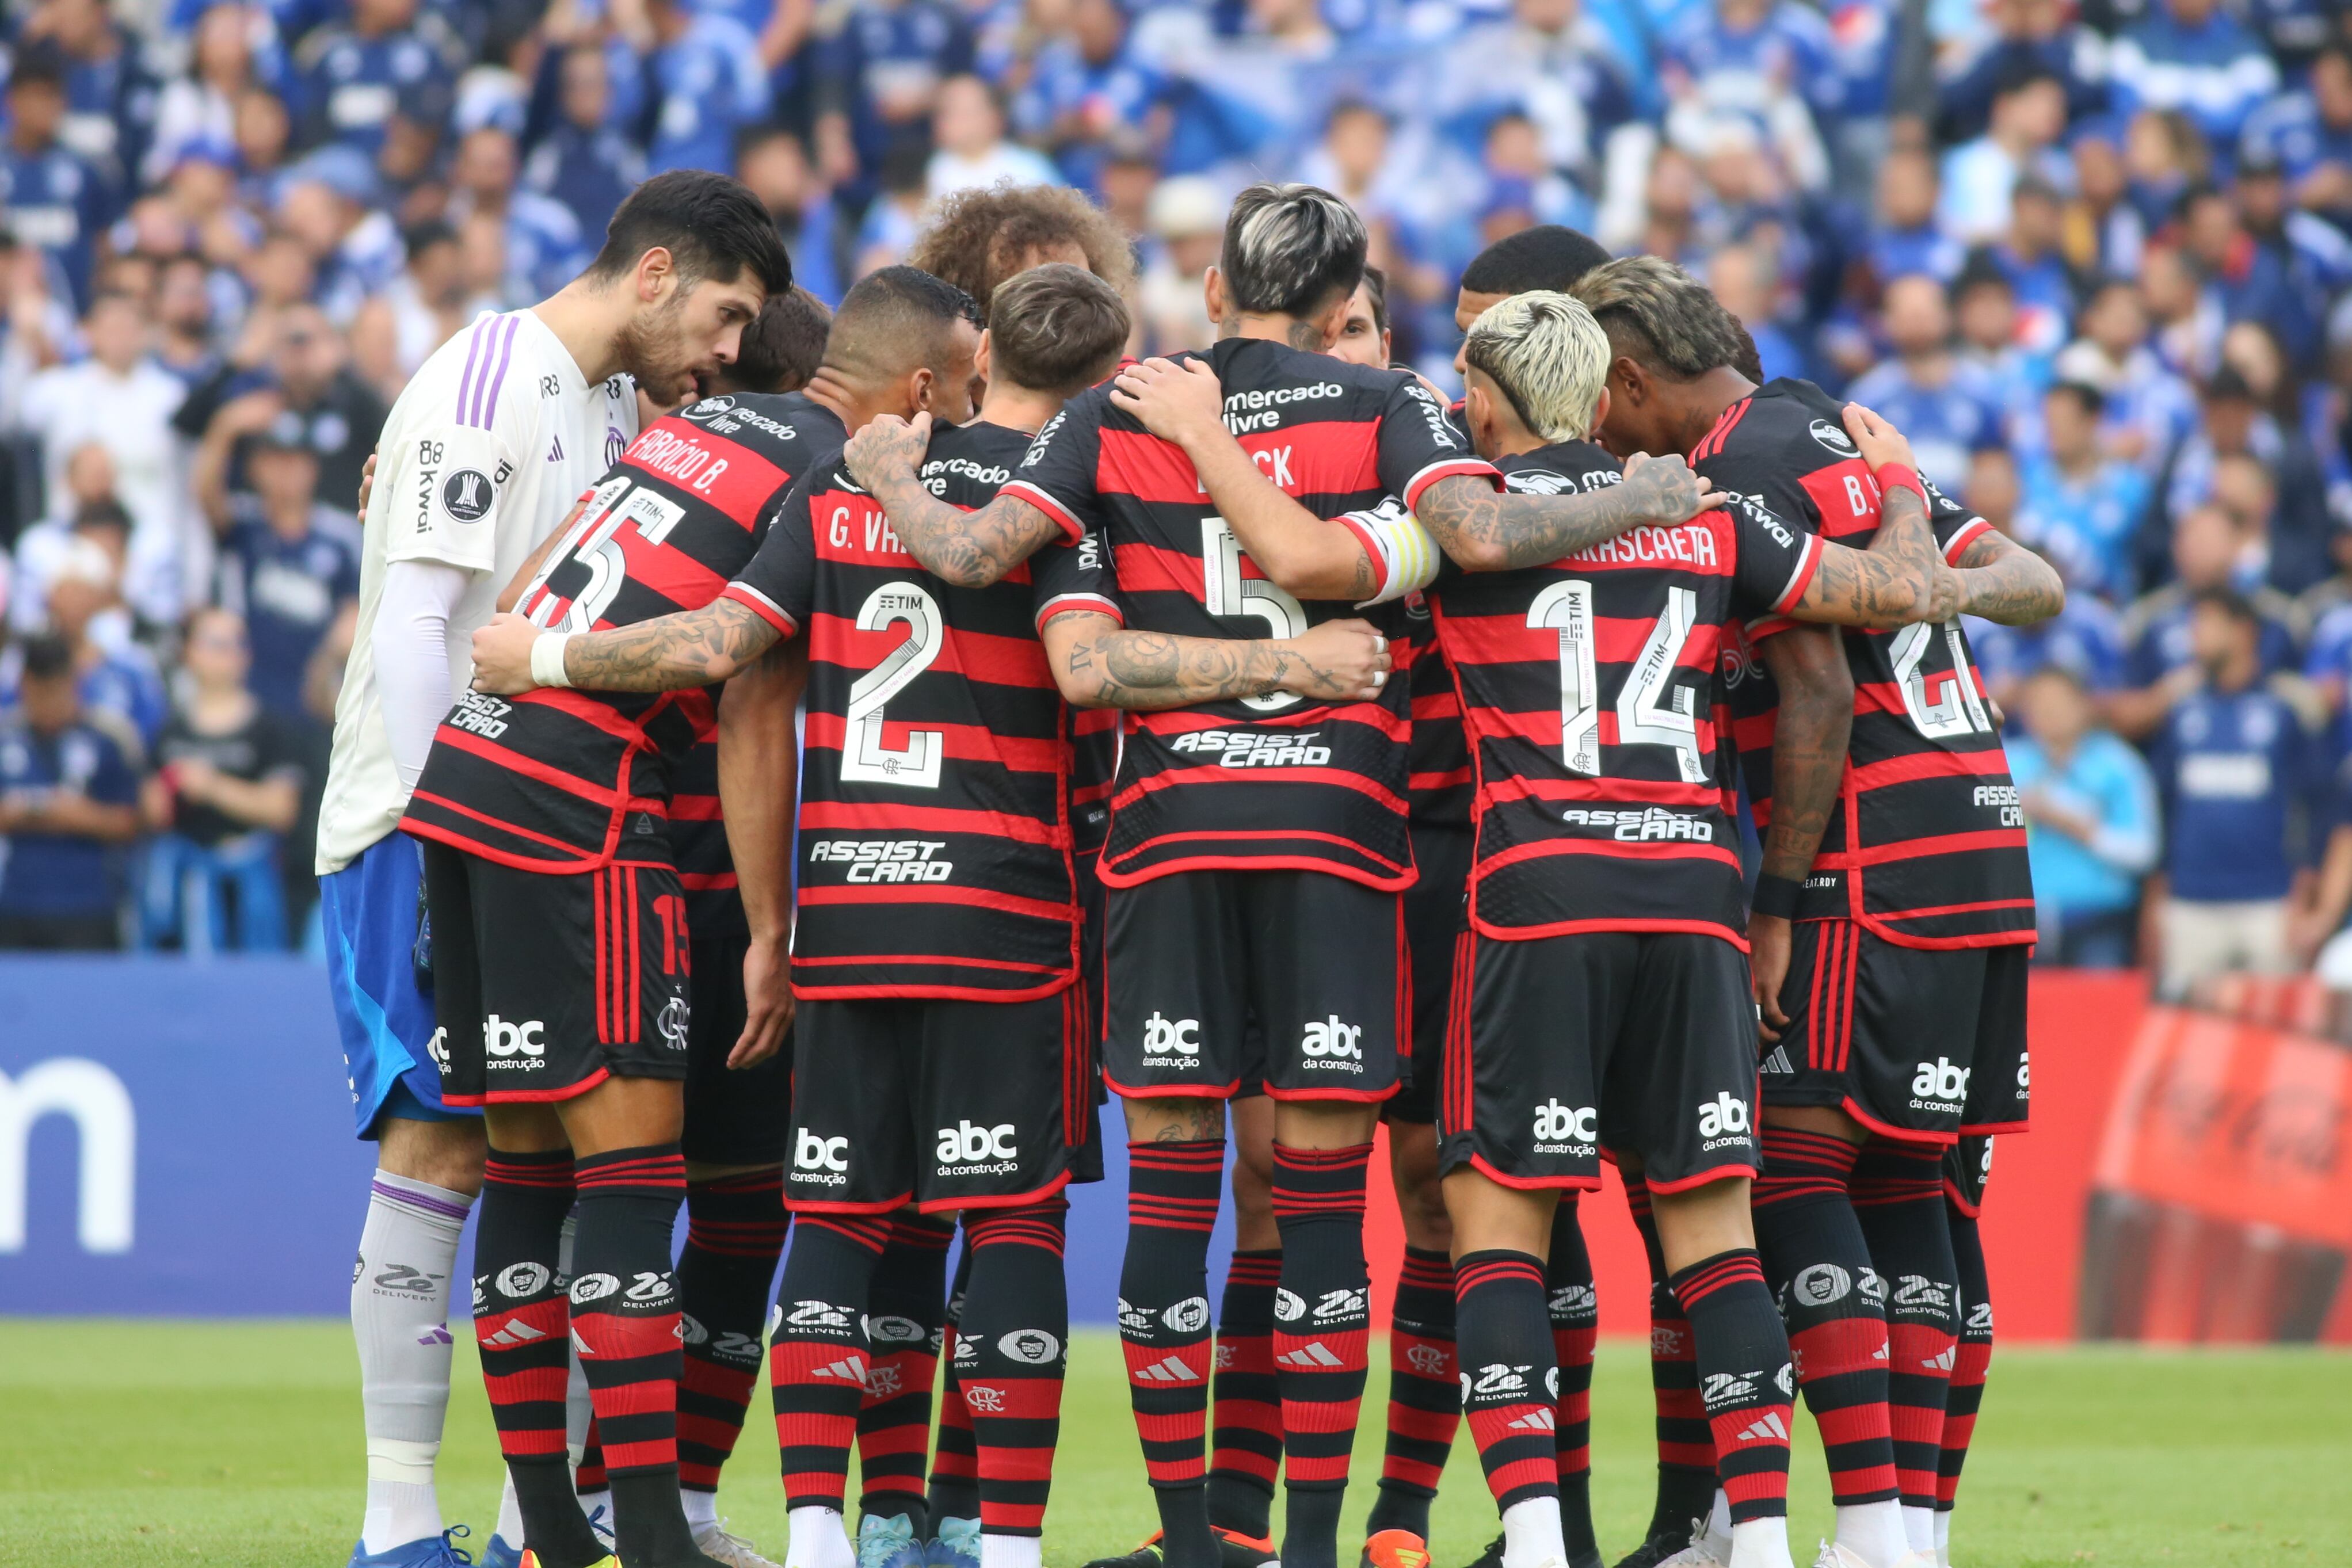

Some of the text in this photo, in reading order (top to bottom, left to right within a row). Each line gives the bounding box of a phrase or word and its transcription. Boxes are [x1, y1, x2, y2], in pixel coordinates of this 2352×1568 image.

[606, 378, 621, 399] RB
[1224, 382, 1343, 413] mercado
[707, 415, 742, 434] livre
[727, 407, 796, 440] mercado
[626, 428, 710, 479] FABRÍCIO
[596, 486, 620, 507] TIM
[449, 506, 481, 516] LIBERTADORES
[829, 506, 853, 549] G.
[897, 596, 922, 611] TIM
[1568, 592, 1582, 620] TIM
[1648, 643, 1668, 670] TIM
[841, 581, 944, 788] 2
[1526, 579, 1710, 783] 14
[1170, 730, 1321, 751] ASSIST
[1973, 785, 2019, 807] ASSIS
[1562, 806, 1699, 825] ASSIST
[810, 840, 947, 862] ASSIST
[1802, 878, 1837, 888] EAT.RDY
[653, 894, 690, 978] 15
[1143, 1011, 1199, 1054] abc
[1301, 1014, 1362, 1059] abc
[1302, 1058, 1318, 1069] da
[1698, 1090, 1751, 1138] ab
[1909, 1098, 1923, 1109] da
[1533, 1097, 1597, 1142] abc
[936, 1119, 1017, 1163] abc
[1533, 1141, 1596, 1158] da construção
[1702, 1139, 1715, 1151] da
[937, 1160, 1019, 1177] da construção
[372, 1288, 437, 1302] DELIVERY
[622, 1296, 676, 1308] DELIVERY
[1312, 1313, 1366, 1326] DELIVERY
[788, 1326, 853, 1338] DELIVERY
